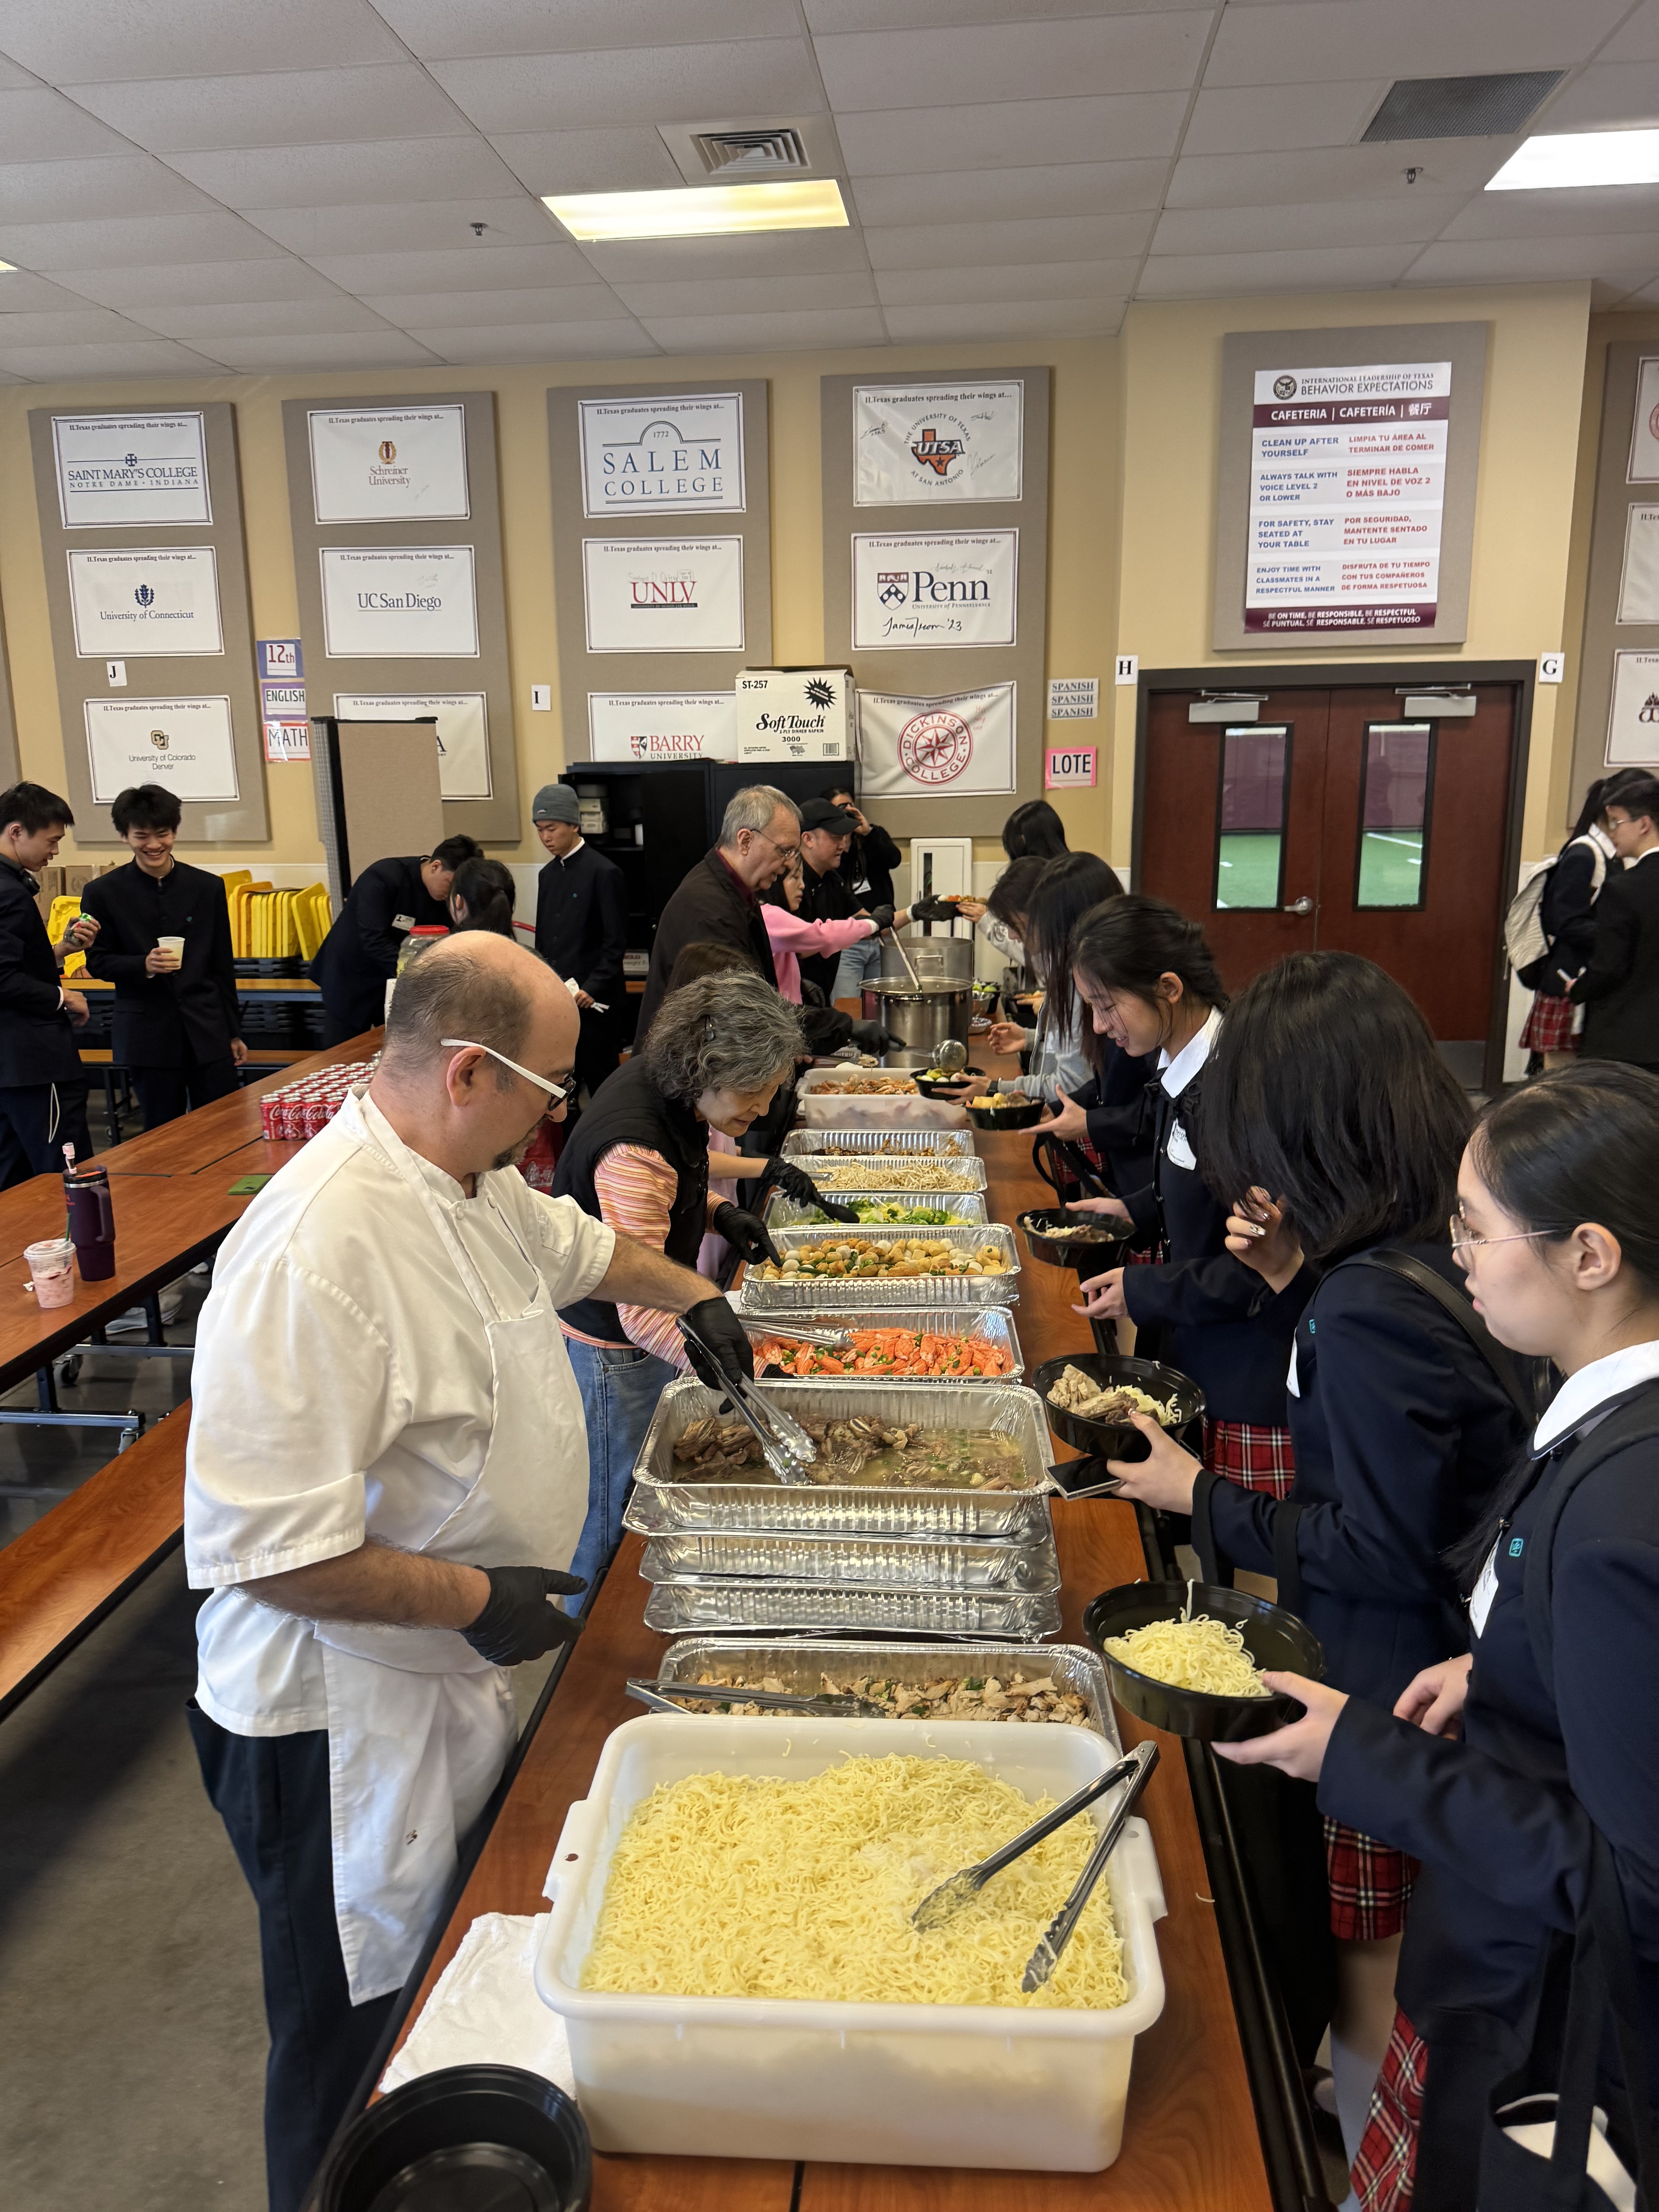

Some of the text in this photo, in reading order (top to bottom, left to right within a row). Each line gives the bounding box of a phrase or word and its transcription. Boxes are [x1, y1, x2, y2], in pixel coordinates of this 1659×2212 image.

[1302, 376, 1357, 384] INTERNATIONAL
[1359, 374, 1401, 382] LEADERSHIP
[1302, 381, 1433, 395] BEHAVIOR EXPECTATIONS
[1271, 404, 1395, 420] CAFETERIA CAFETERÍA
[1409, 403, 1431, 416] 餐厅
[904, 431, 913, 444] THE
[911, 413, 947, 430] UNIVERSITY
[958, 422, 970, 441] TEXAS
[916, 440, 963, 454] UTSA
[1262, 449, 1309, 457] YOURSELF
[603, 449, 721, 474] SALEM
[69, 467, 197, 480] SAINT MARY'S COLLEGE
[370, 465, 408, 476] Schreiner
[919, 476, 932, 486] SAN
[935, 469, 963, 486] ANTONIO
[369, 476, 410, 488] University
[605, 477, 723, 496] COLLEGE
[630, 581, 697, 603] UNLV
[912, 572, 990, 602] Penn
[358, 593, 441, 611] UC San Diego
[100, 610, 194, 622] University of Connecticut
[1317, 610, 1363, 618] RESPONSIBLE,
[948, 619, 962, 631] '23
[268, 645, 294, 663] 12th
[109, 666, 116, 678] J
[1119, 661, 1133, 675] H
[1542, 660, 1557, 675] G
[1052, 682, 1094, 692] SPANISH
[266, 690, 305, 702] ENGLISH
[534, 691, 540, 704] I
[1052, 695, 1093, 704] SPANISH
[1051, 708, 1093, 717] SPANISH
[756, 713, 824, 732] Soft Touch
[268, 729, 308, 746] MATH
[903, 715, 967, 749] DICKINSON
[650, 735, 704, 751] BARRY
[905, 755, 967, 780] COLLEGE
[1052, 754, 1091, 774] LOTE
